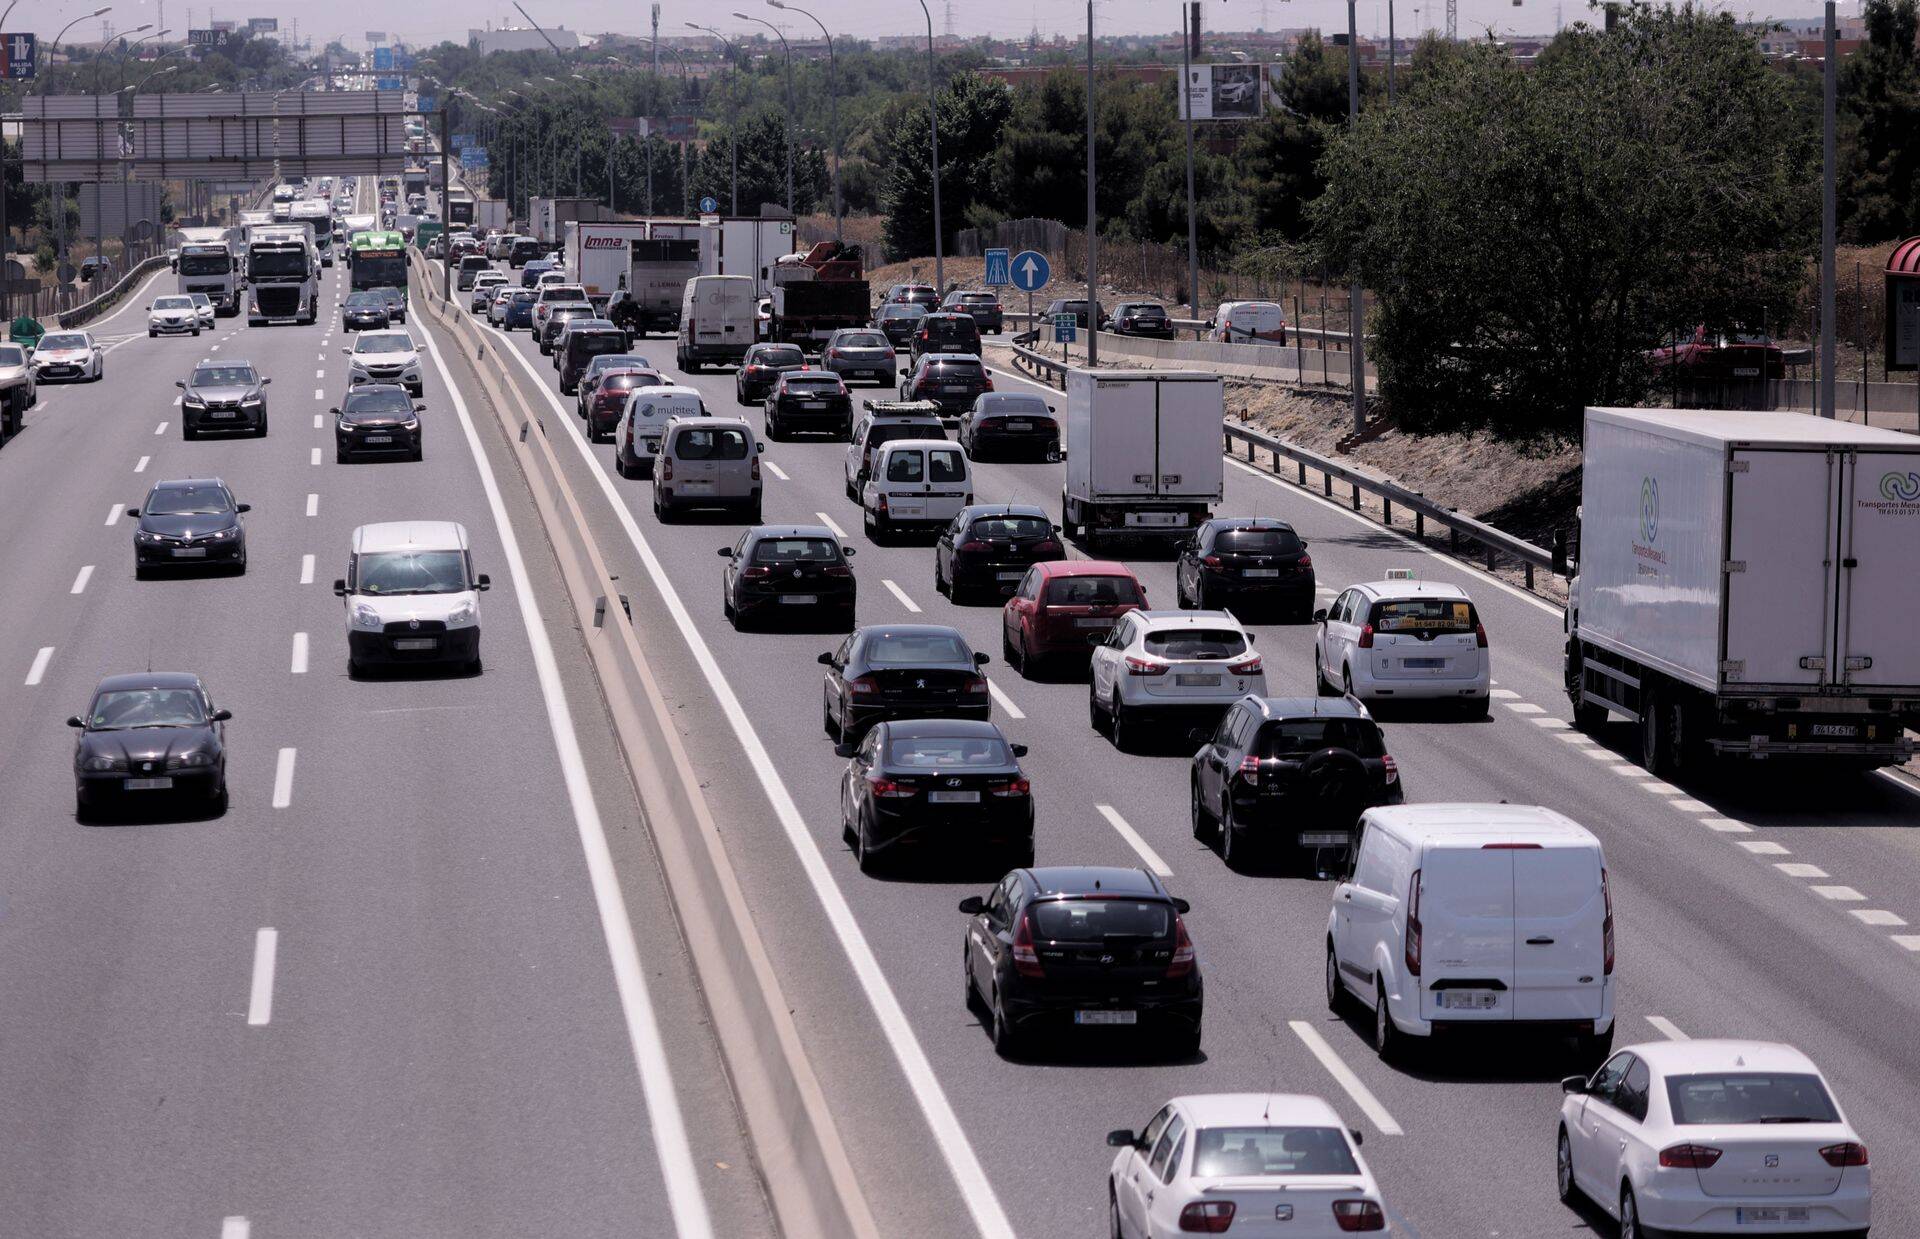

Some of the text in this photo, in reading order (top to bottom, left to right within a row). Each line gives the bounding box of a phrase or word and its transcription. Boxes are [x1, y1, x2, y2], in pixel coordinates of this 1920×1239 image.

[1061, 334, 1070, 342] 18
[657, 406, 696, 415] multitec
[1858, 501, 1899, 509] Transportes
